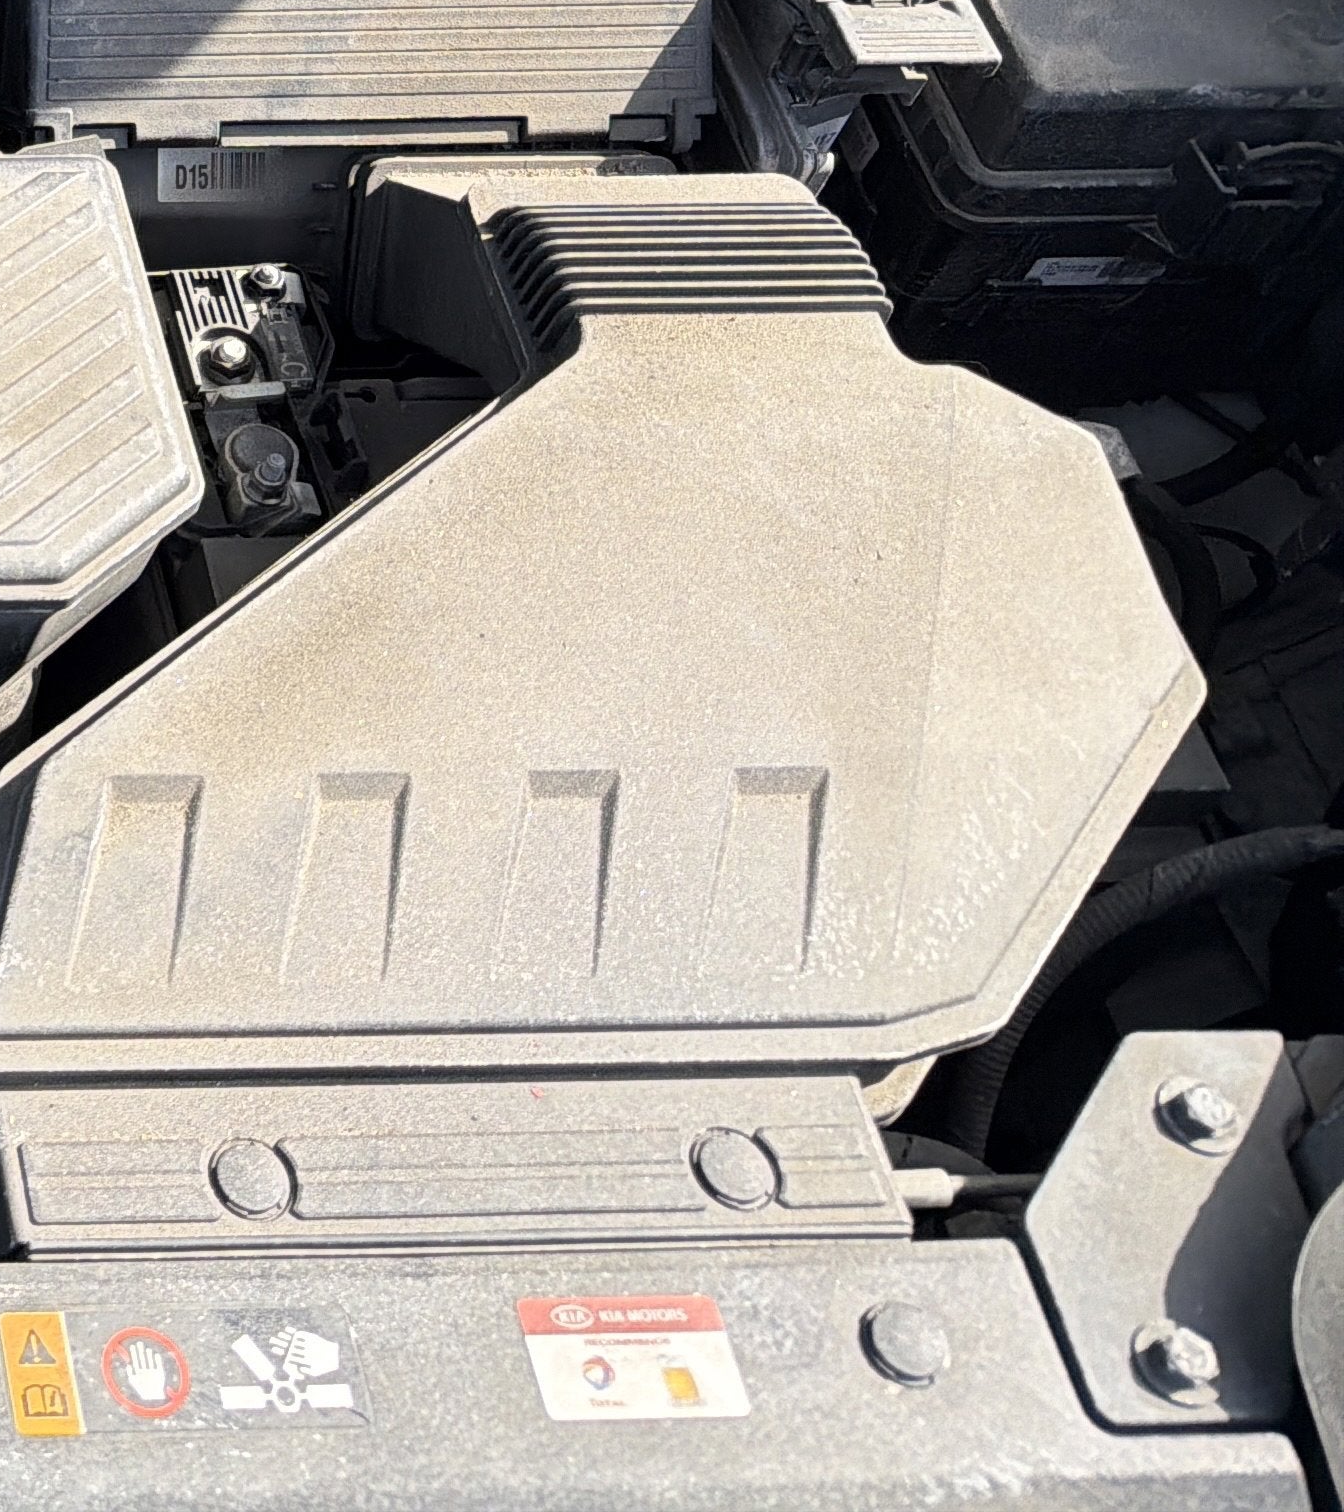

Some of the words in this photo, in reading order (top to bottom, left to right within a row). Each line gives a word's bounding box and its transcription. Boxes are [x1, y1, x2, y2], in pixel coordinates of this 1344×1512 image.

[175, 164, 209, 190] D15
[598, 1309, 625, 1324] KIA
[627, 1307, 689, 1323] MOTORS
